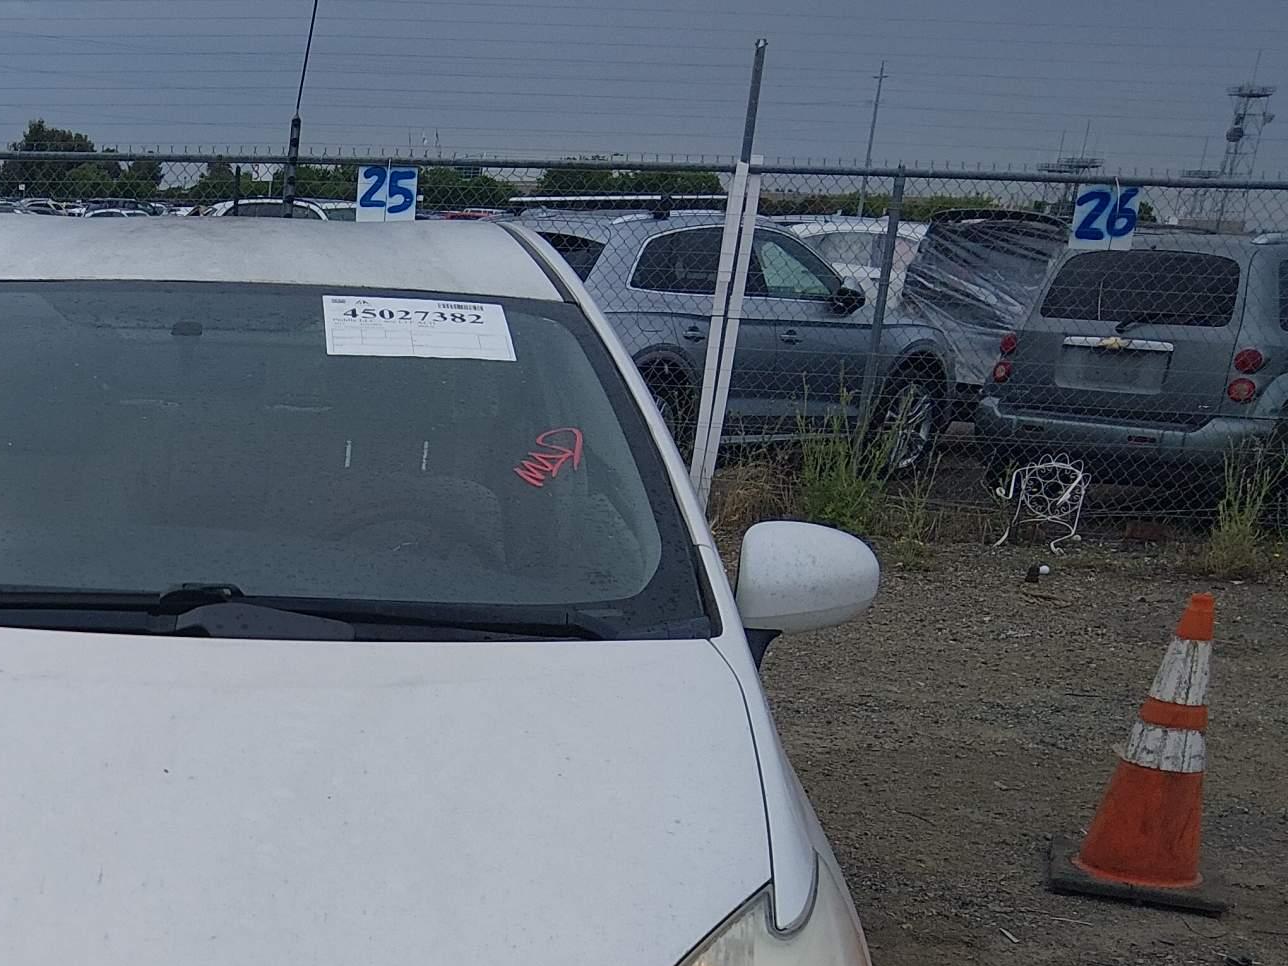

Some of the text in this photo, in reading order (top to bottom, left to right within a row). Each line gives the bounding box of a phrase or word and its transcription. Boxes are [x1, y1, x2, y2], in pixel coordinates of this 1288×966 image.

[360, 166, 416, 213] 25
[1075, 187, 1139, 240] 26
[343, 307, 484, 325] 45027382
